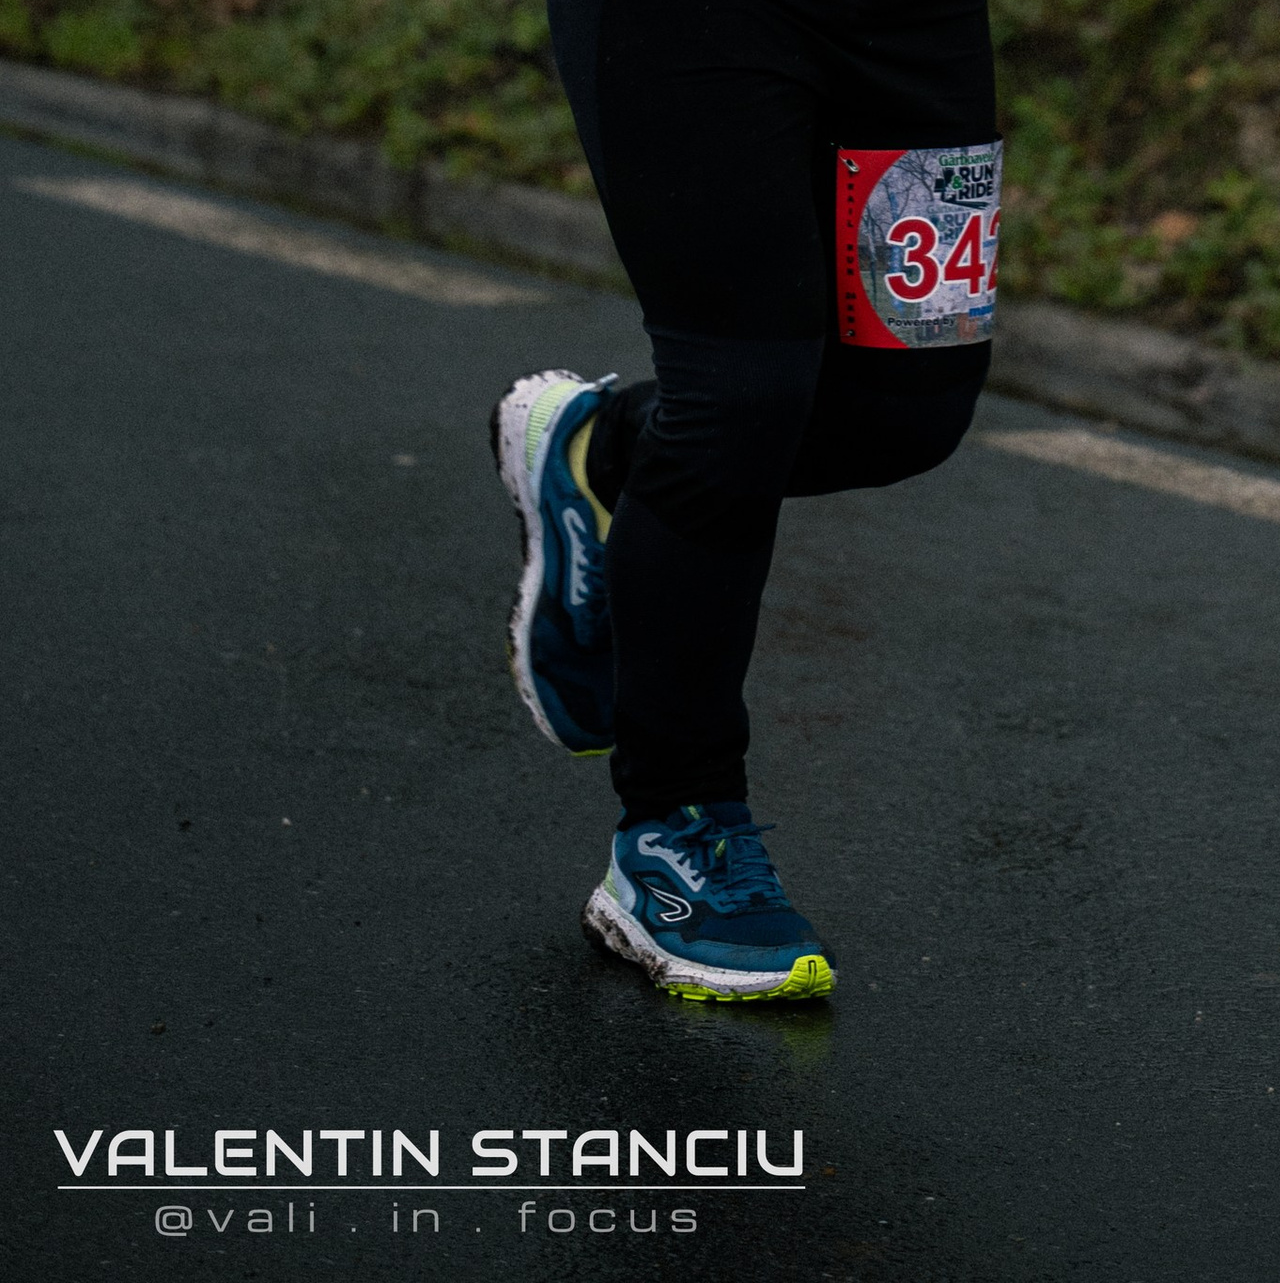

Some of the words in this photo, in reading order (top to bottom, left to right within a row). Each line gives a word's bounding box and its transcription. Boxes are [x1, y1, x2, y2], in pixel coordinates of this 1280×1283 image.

[959, 163, 994, 183] RUN
[958, 181, 993, 200] RIDE
[888, 318, 940, 327] Powered
[943, 315, 956, 327] by
